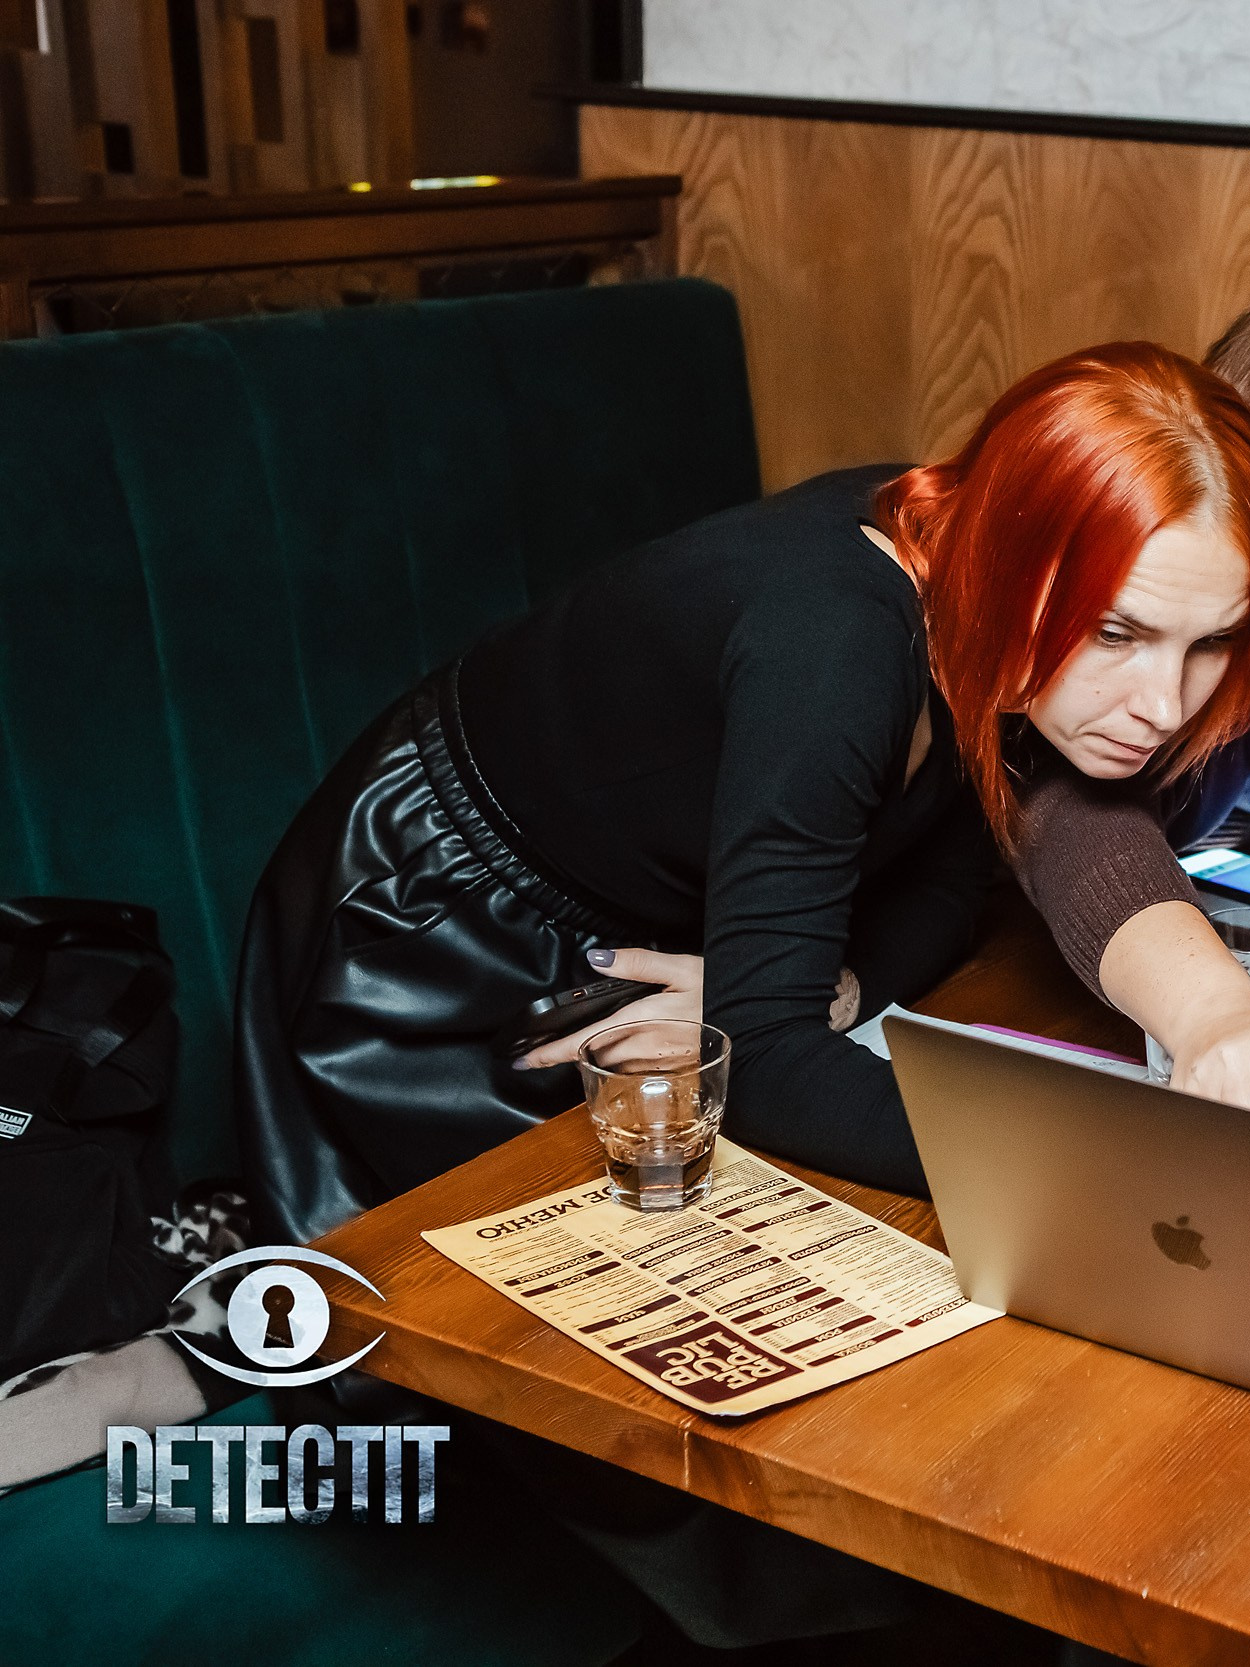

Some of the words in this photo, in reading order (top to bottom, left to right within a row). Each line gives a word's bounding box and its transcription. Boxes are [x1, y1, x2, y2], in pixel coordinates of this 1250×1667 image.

[735, 1193, 783, 1211] КОНЬЯК
[476, 1199, 584, 1239] МЕНЮ
[762, 1207, 810, 1225] БРЕНДИ
[648, 1221, 714, 1247] БУТЫЛОЧНОЕ
[670, 1231, 727, 1255] РАЗЛИВНОЕ
[817, 1225, 872, 1249] ФИРМЕННЫЕ
[622, 1245, 652, 1259] ПИВО
[642, 1252, 674, 1267] ПИВО
[709, 1251, 745, 1266] ТИХИЕ
[789, 1245, 822, 1259] ШОТЫ
[515, 1254, 591, 1283] ЛИМОНАДЫ
[681, 1263, 713, 1277] ВИНА
[719, 1259, 774, 1282] ИГРИСТЫЕ
[552, 1272, 590, 1288] КОФЕ
[692, 1279, 723, 1294] ВИНА
[757, 1296, 801, 1314] ДЖИН
[770, 1305, 823, 1328] ТЕКИЛА
[812, 1327, 844, 1342] РОМ
[654, 1330, 740, 1366] LIC
[832, 1339, 878, 1358] ВОДКА
[660, 1343, 763, 1387] PUB
[711, 1356, 789, 1389] RE
